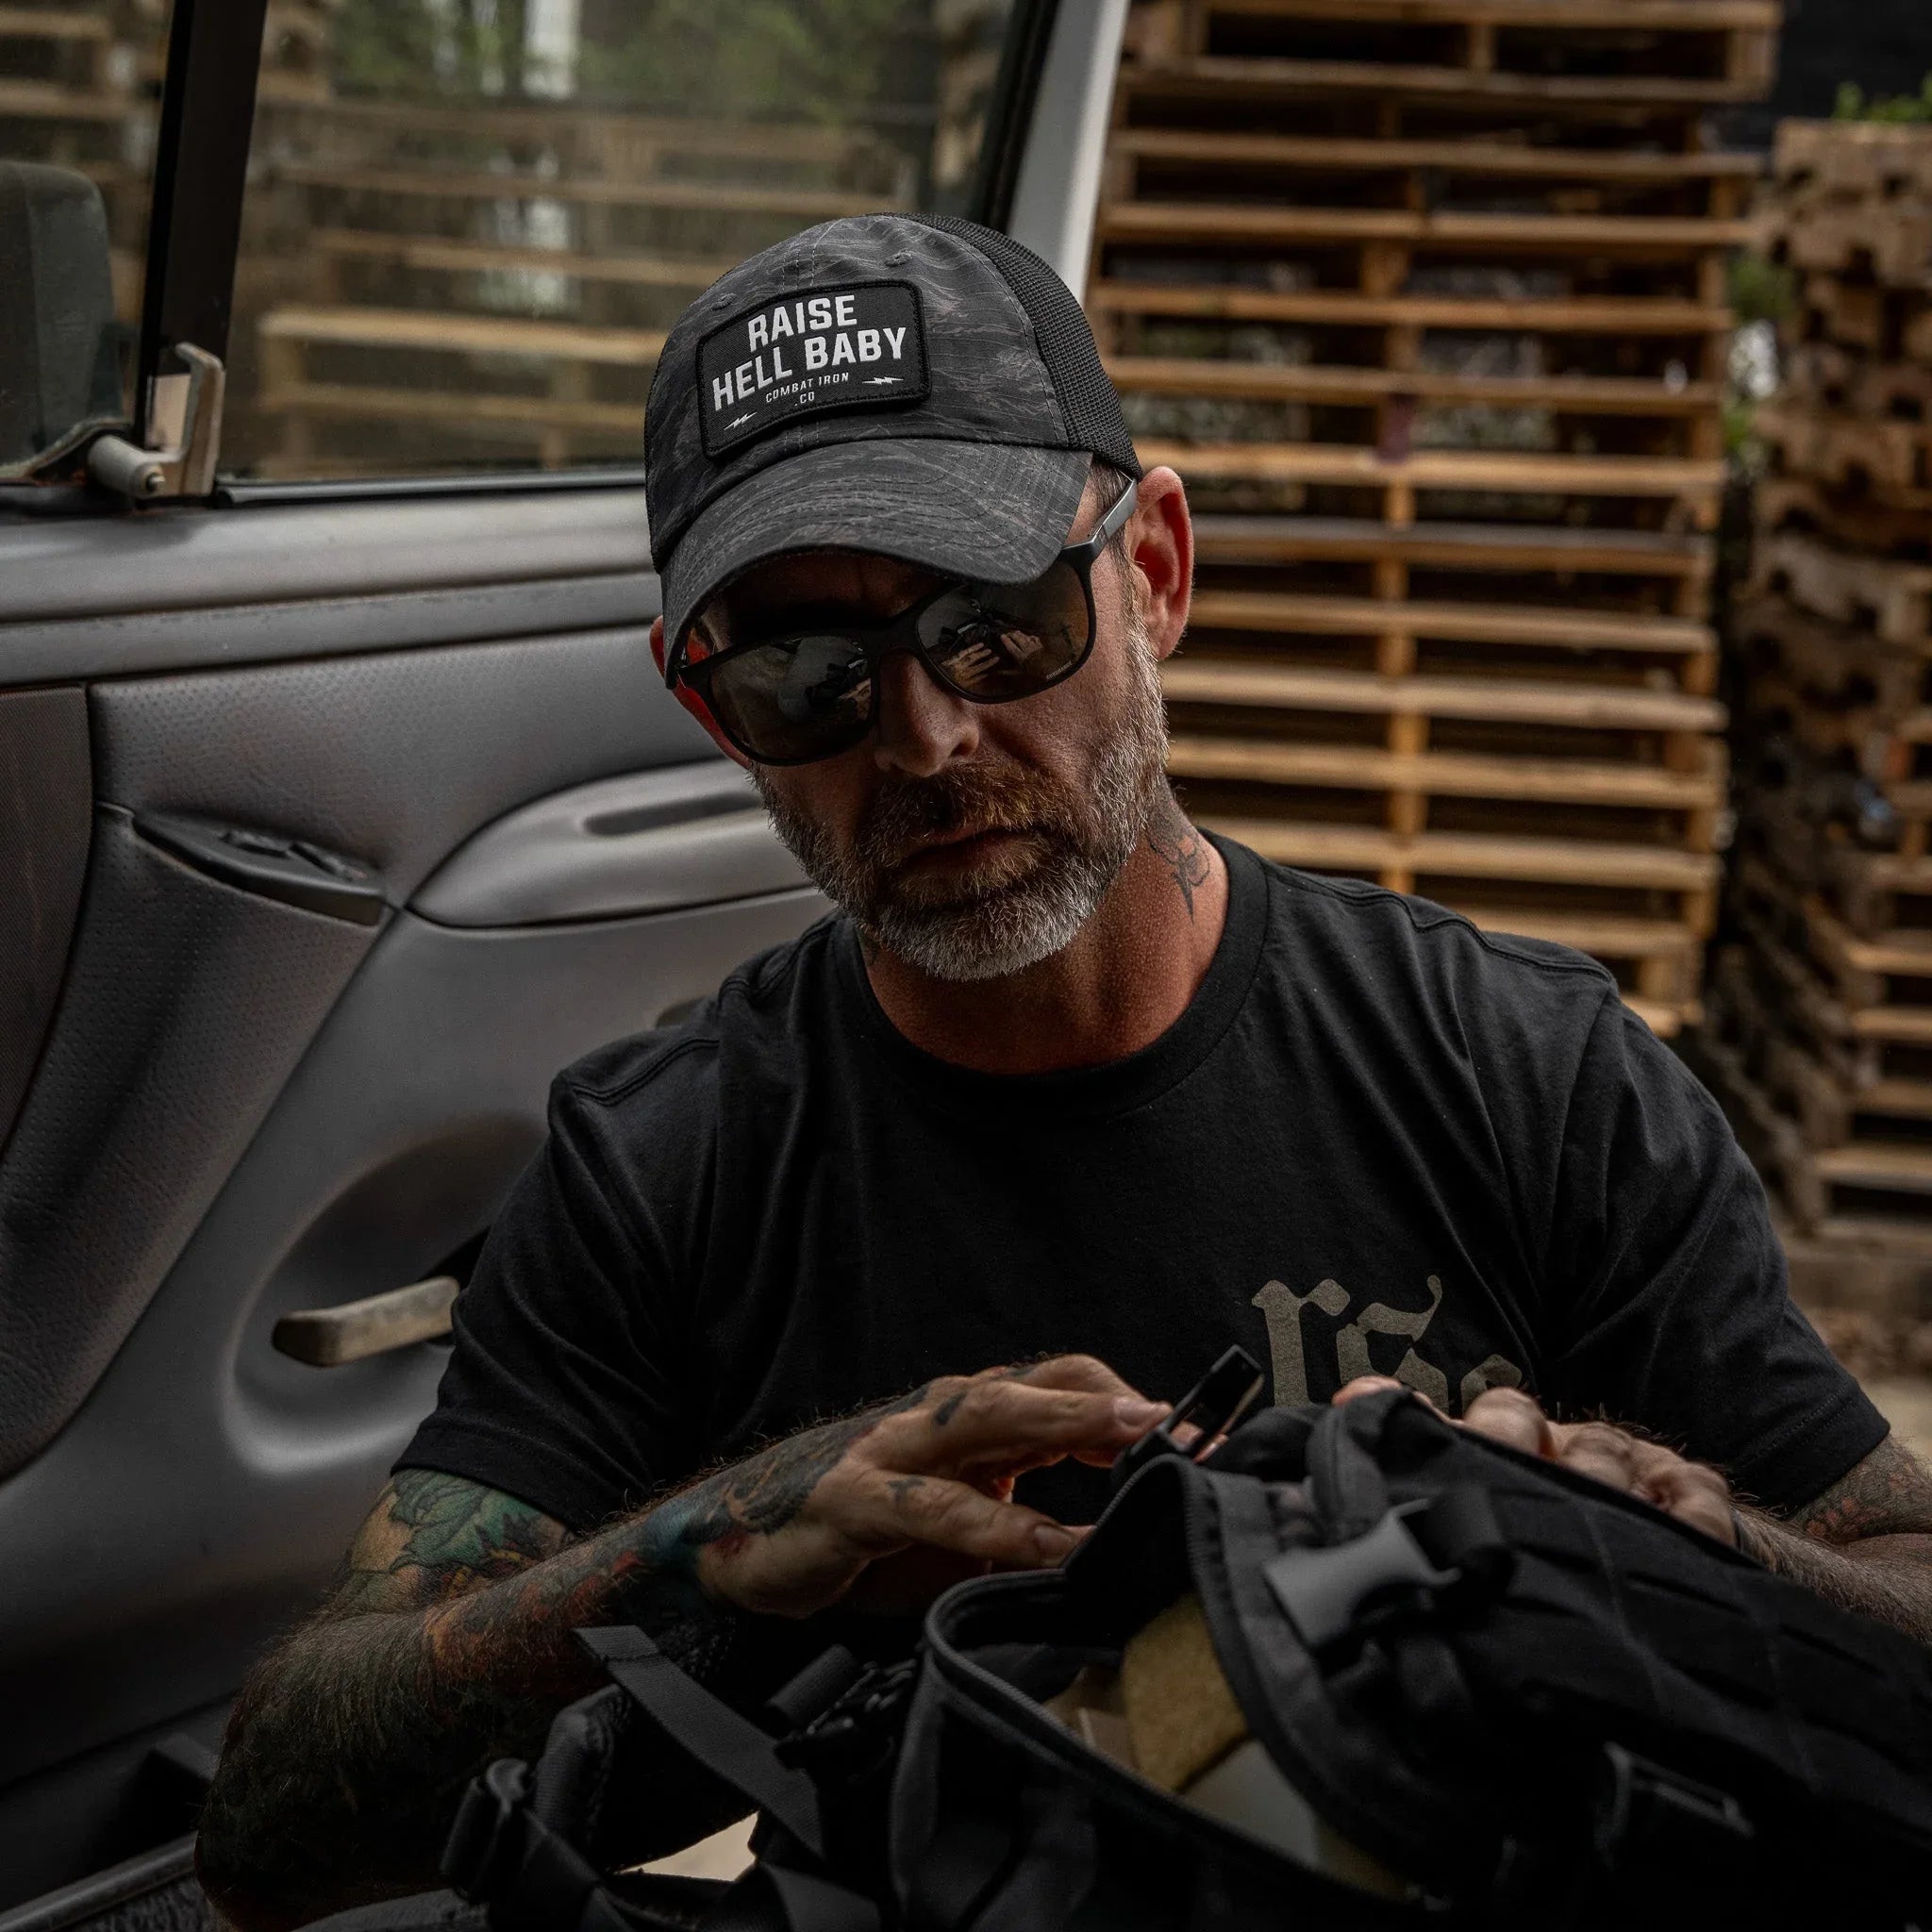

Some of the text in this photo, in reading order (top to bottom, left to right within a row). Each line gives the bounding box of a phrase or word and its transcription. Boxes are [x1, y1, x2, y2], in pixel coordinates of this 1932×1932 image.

[747, 295, 858, 352] RAISE
[712, 327, 907, 411] HELL BABY
[765, 373, 849, 403] COMBAT IRON
